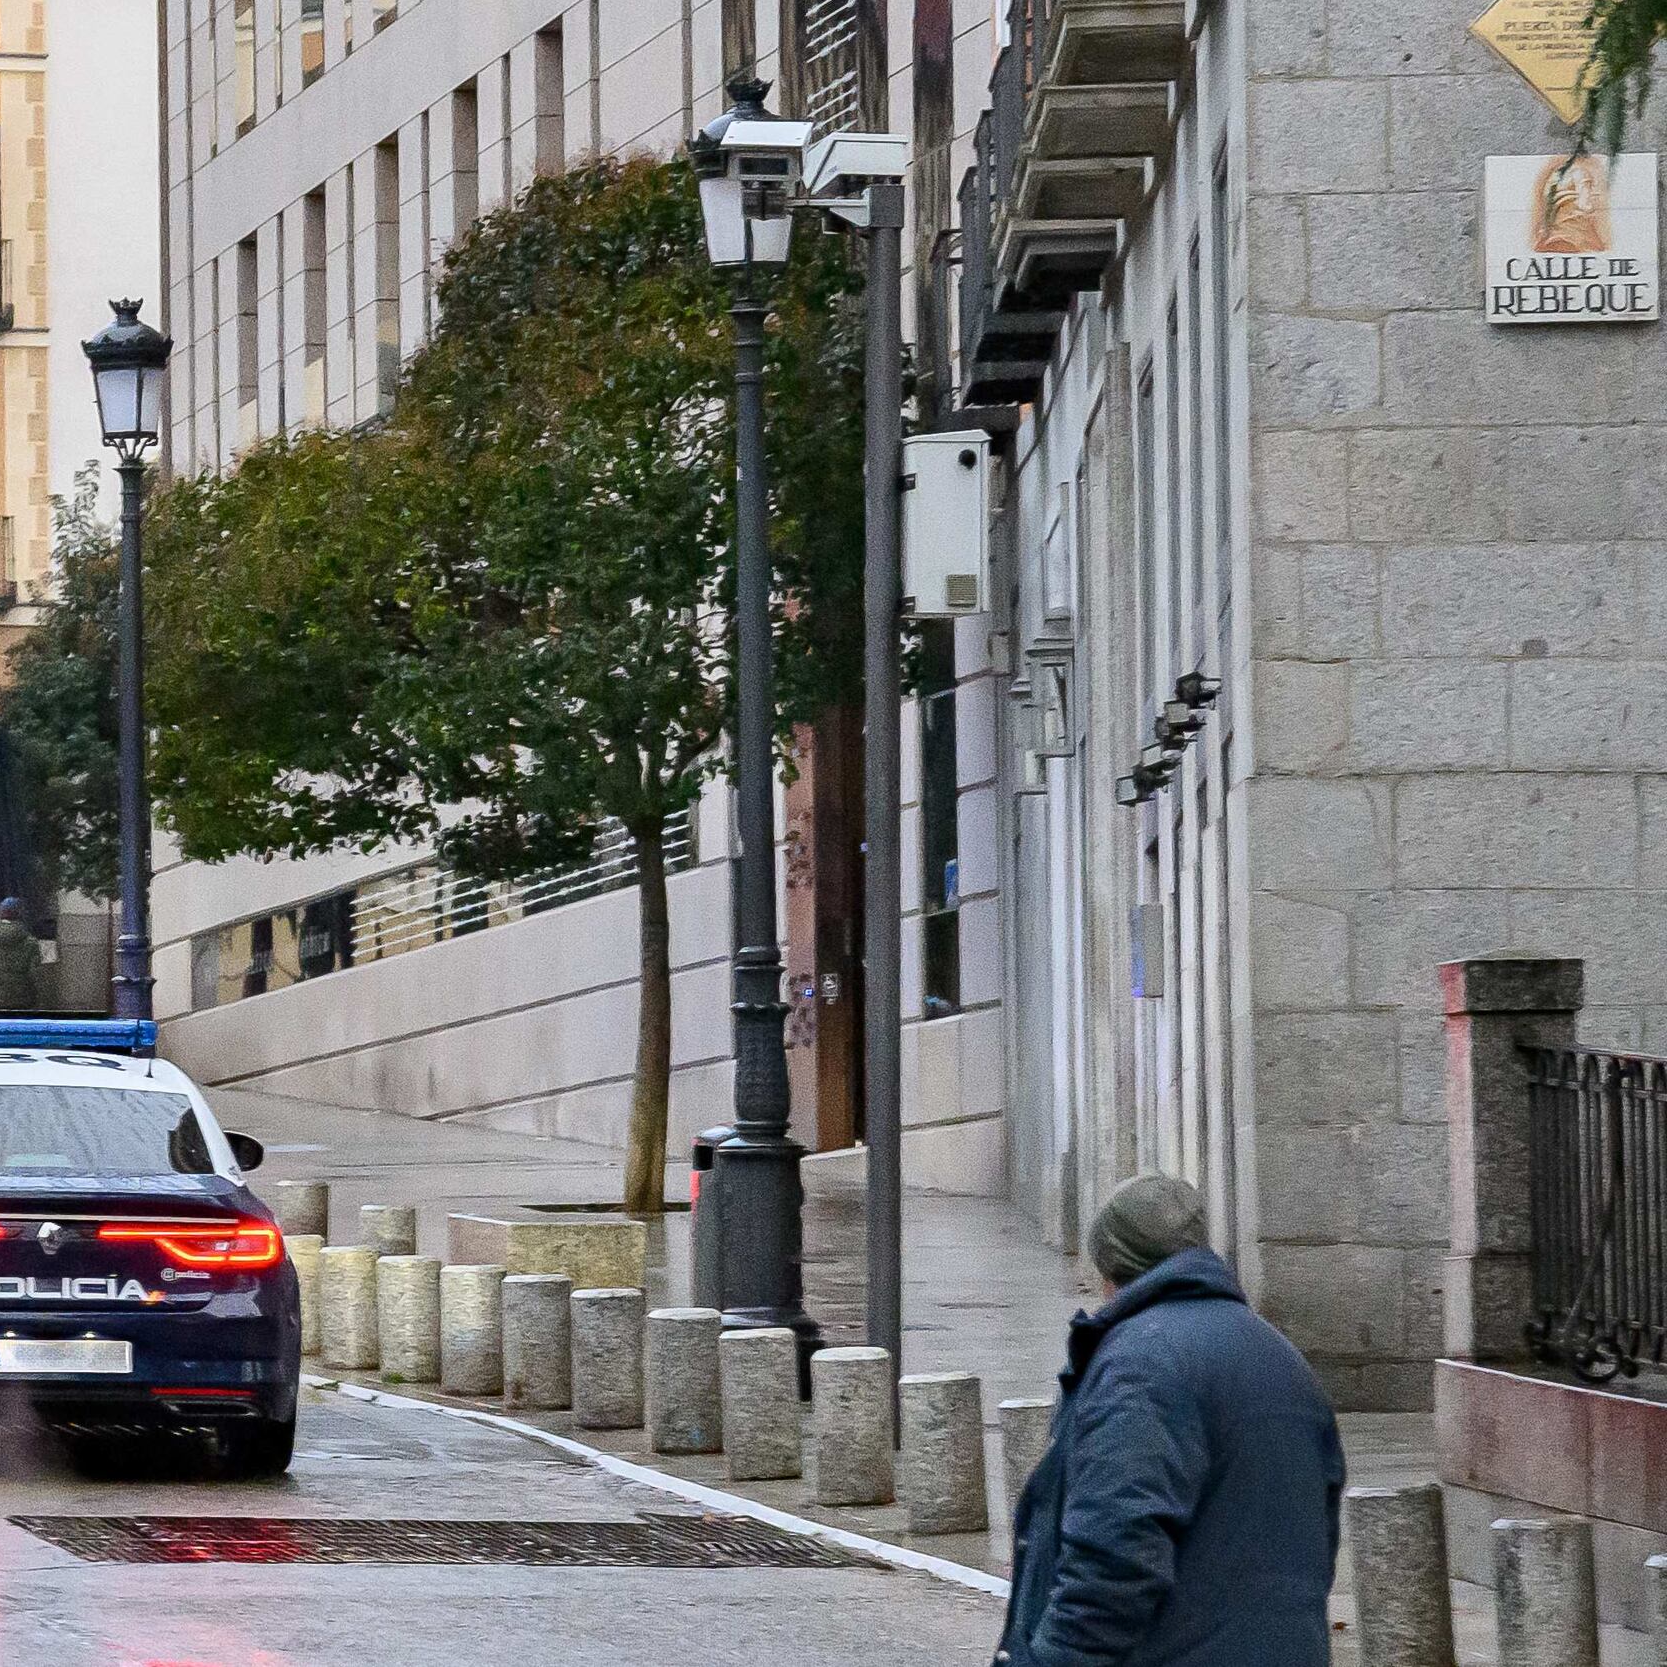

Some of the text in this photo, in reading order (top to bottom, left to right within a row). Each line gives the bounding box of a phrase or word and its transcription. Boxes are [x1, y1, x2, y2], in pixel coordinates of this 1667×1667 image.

[1506, 257, 1641, 281] CALLE DE
[1491, 283, 1654, 315] REBEQUE
